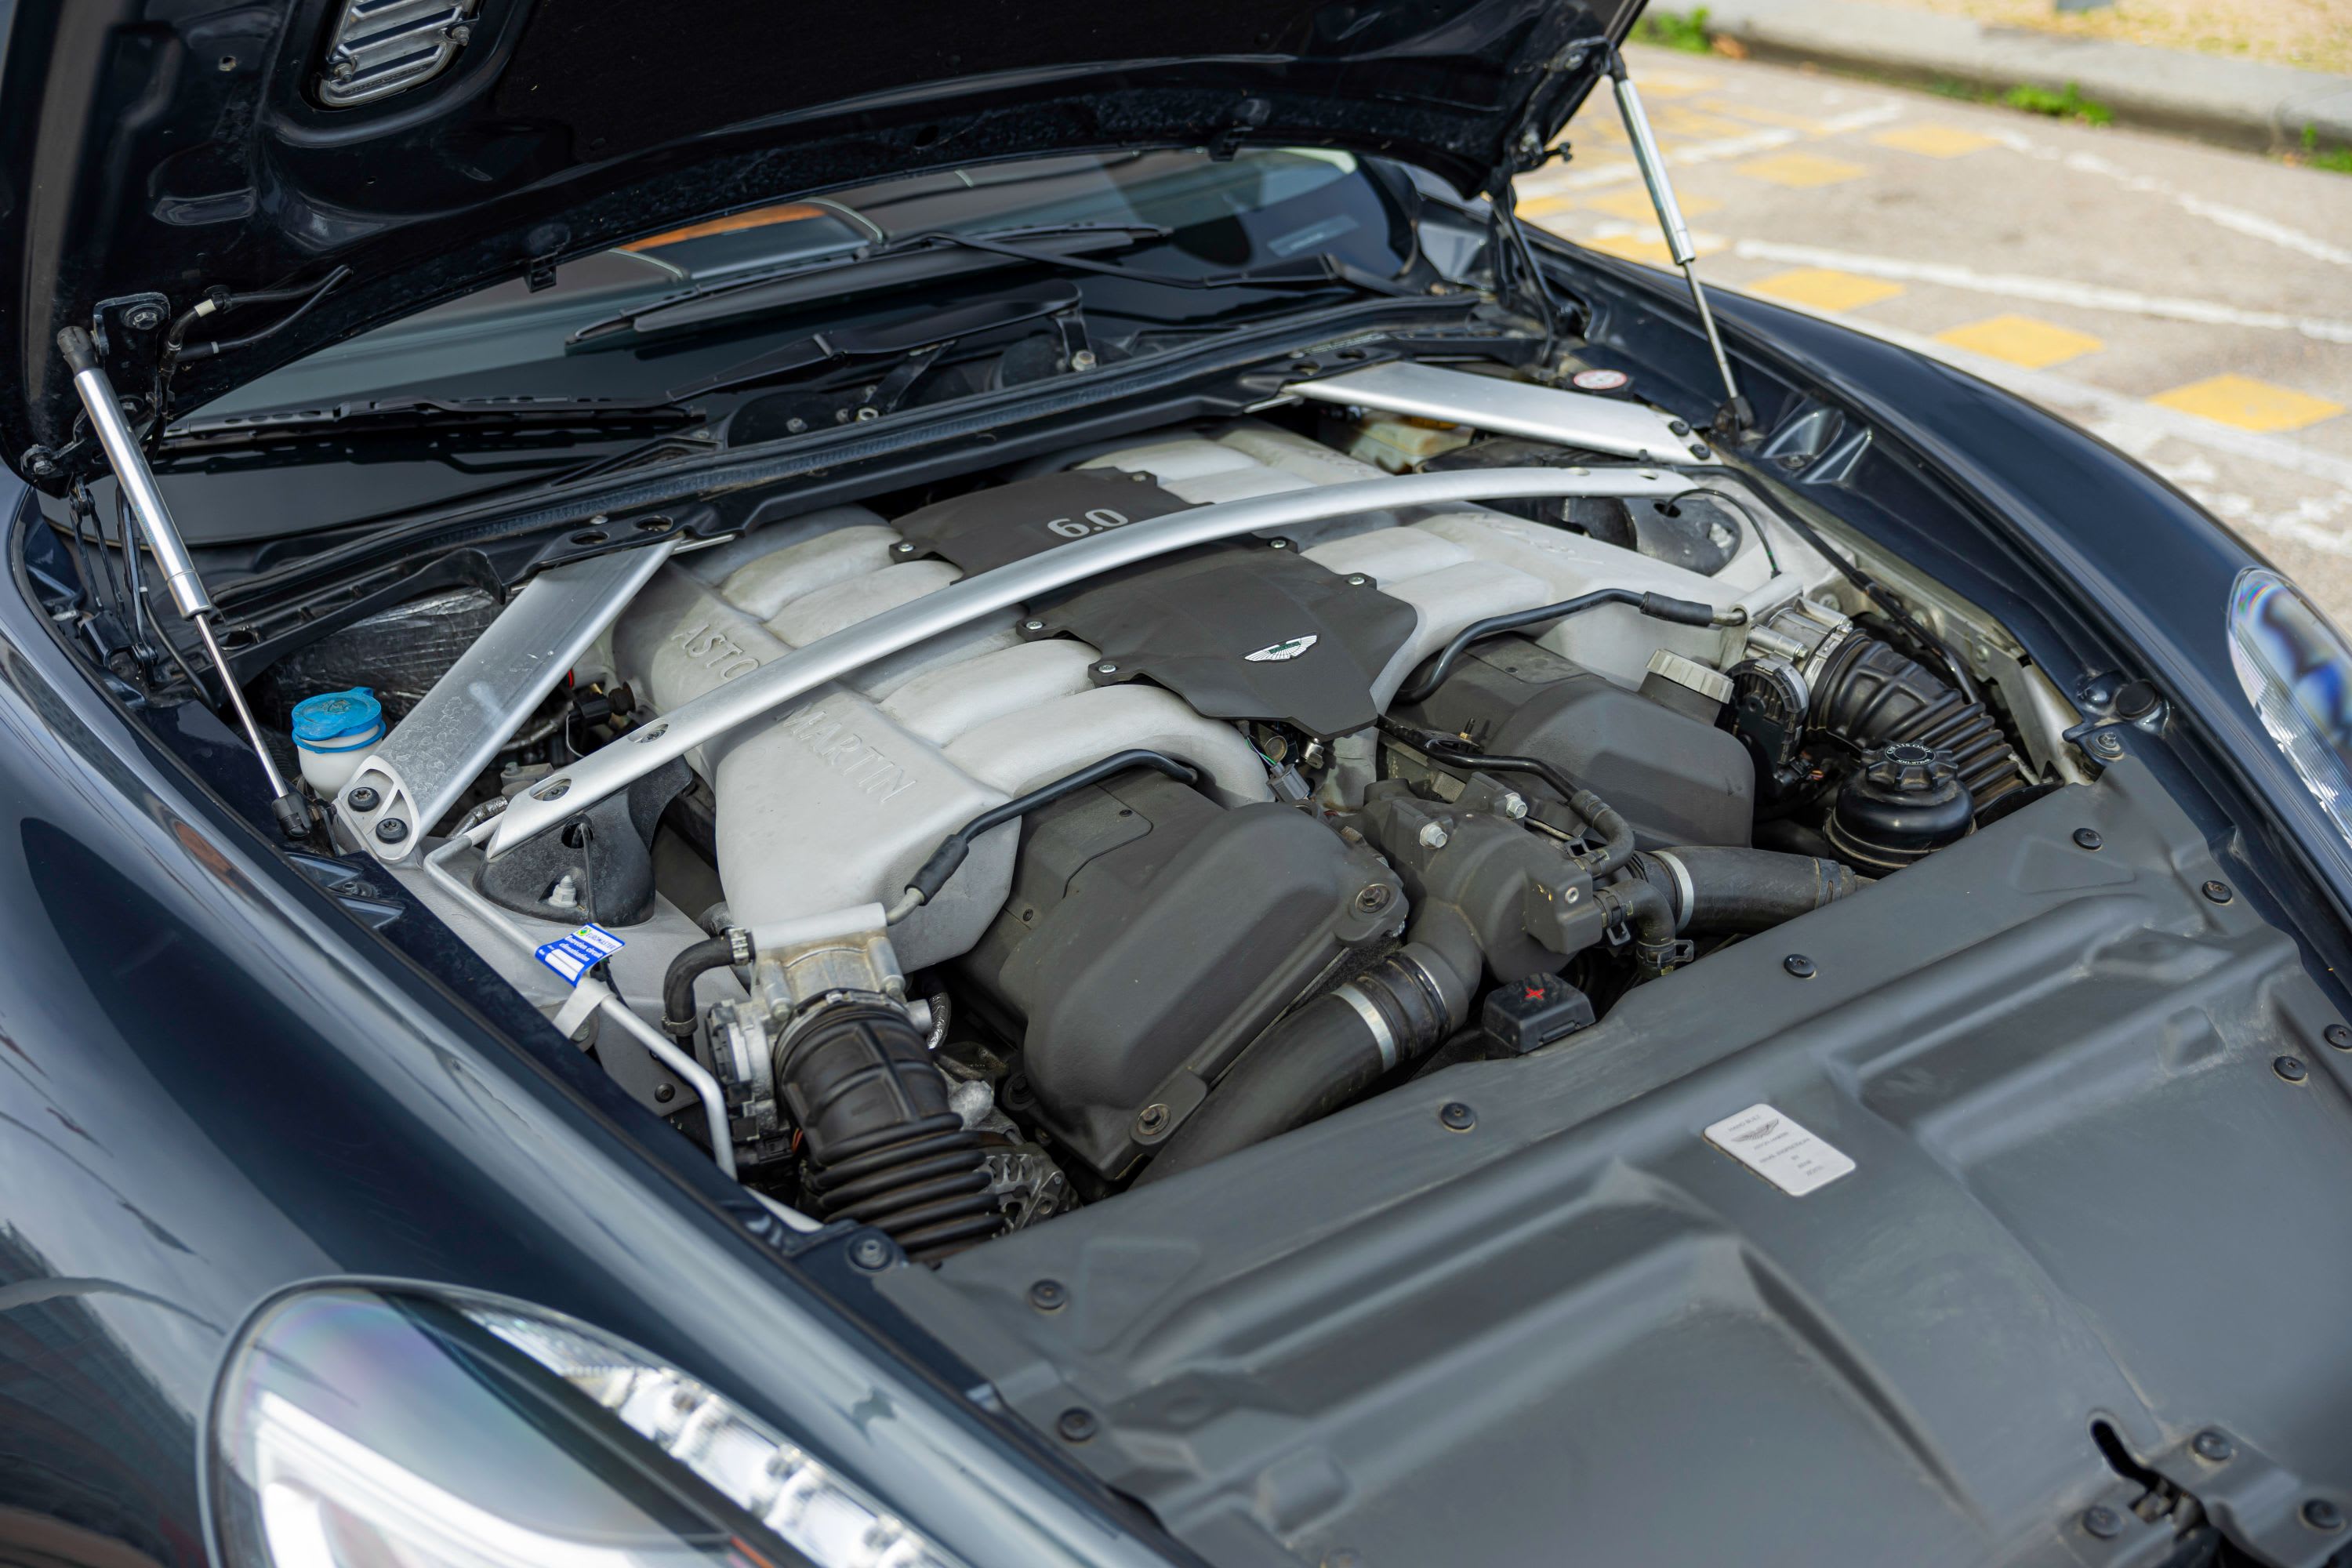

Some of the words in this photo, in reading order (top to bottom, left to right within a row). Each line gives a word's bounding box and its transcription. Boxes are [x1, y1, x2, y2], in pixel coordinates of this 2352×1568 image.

[1047, 508, 1129, 538] 6.0
[671, 623, 760, 680] ASTO
[775, 702, 916, 804] MARTIN
[1912, 744, 1932, 753] ONLY
